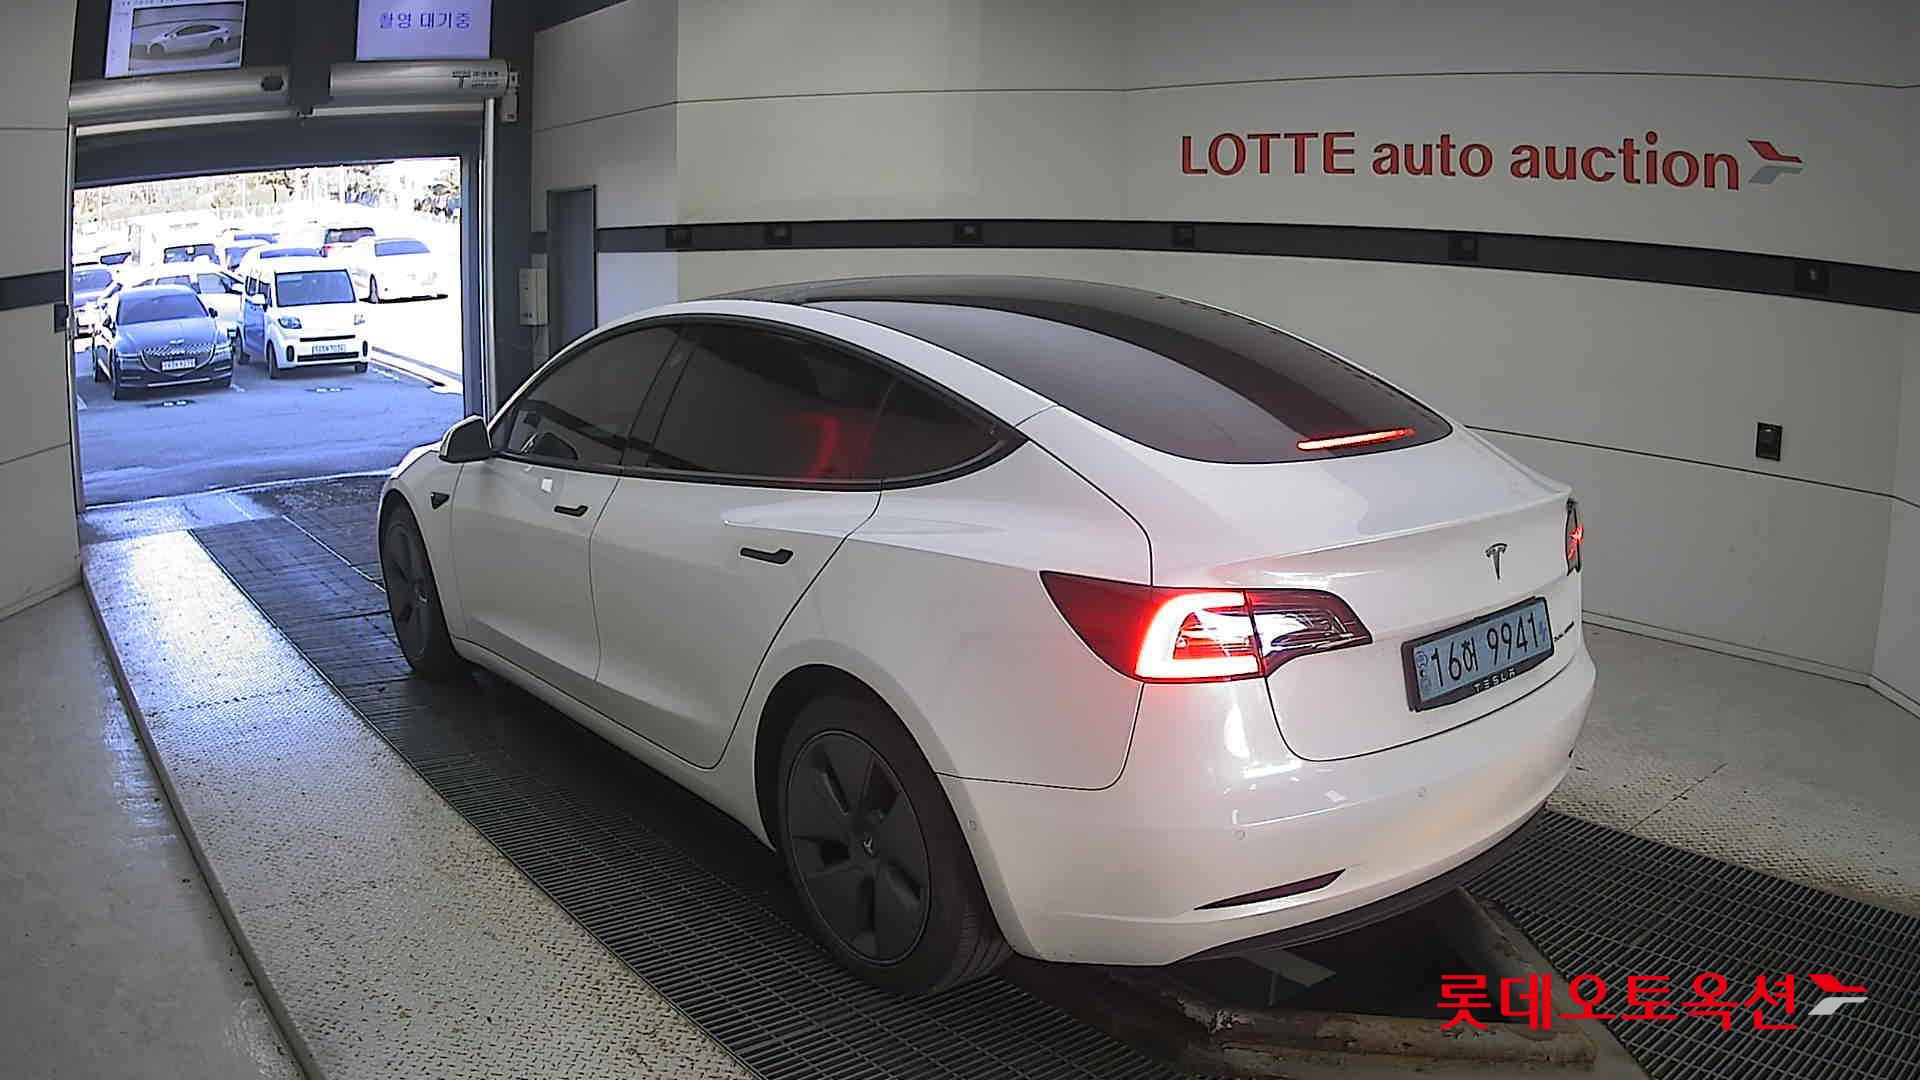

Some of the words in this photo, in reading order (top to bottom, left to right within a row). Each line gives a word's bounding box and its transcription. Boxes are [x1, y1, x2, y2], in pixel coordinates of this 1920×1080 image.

[420, 12, 470, 29] 대기중
[1181, 131, 1356, 176] LOTTE
[1371, 133, 1494, 178] auto
[1510, 130, 1740, 191] auction
[1430, 636, 1478, 688] 16허
[1486, 611, 1538, 665] 9941
[1472, 667, 1517, 693] TESLA
